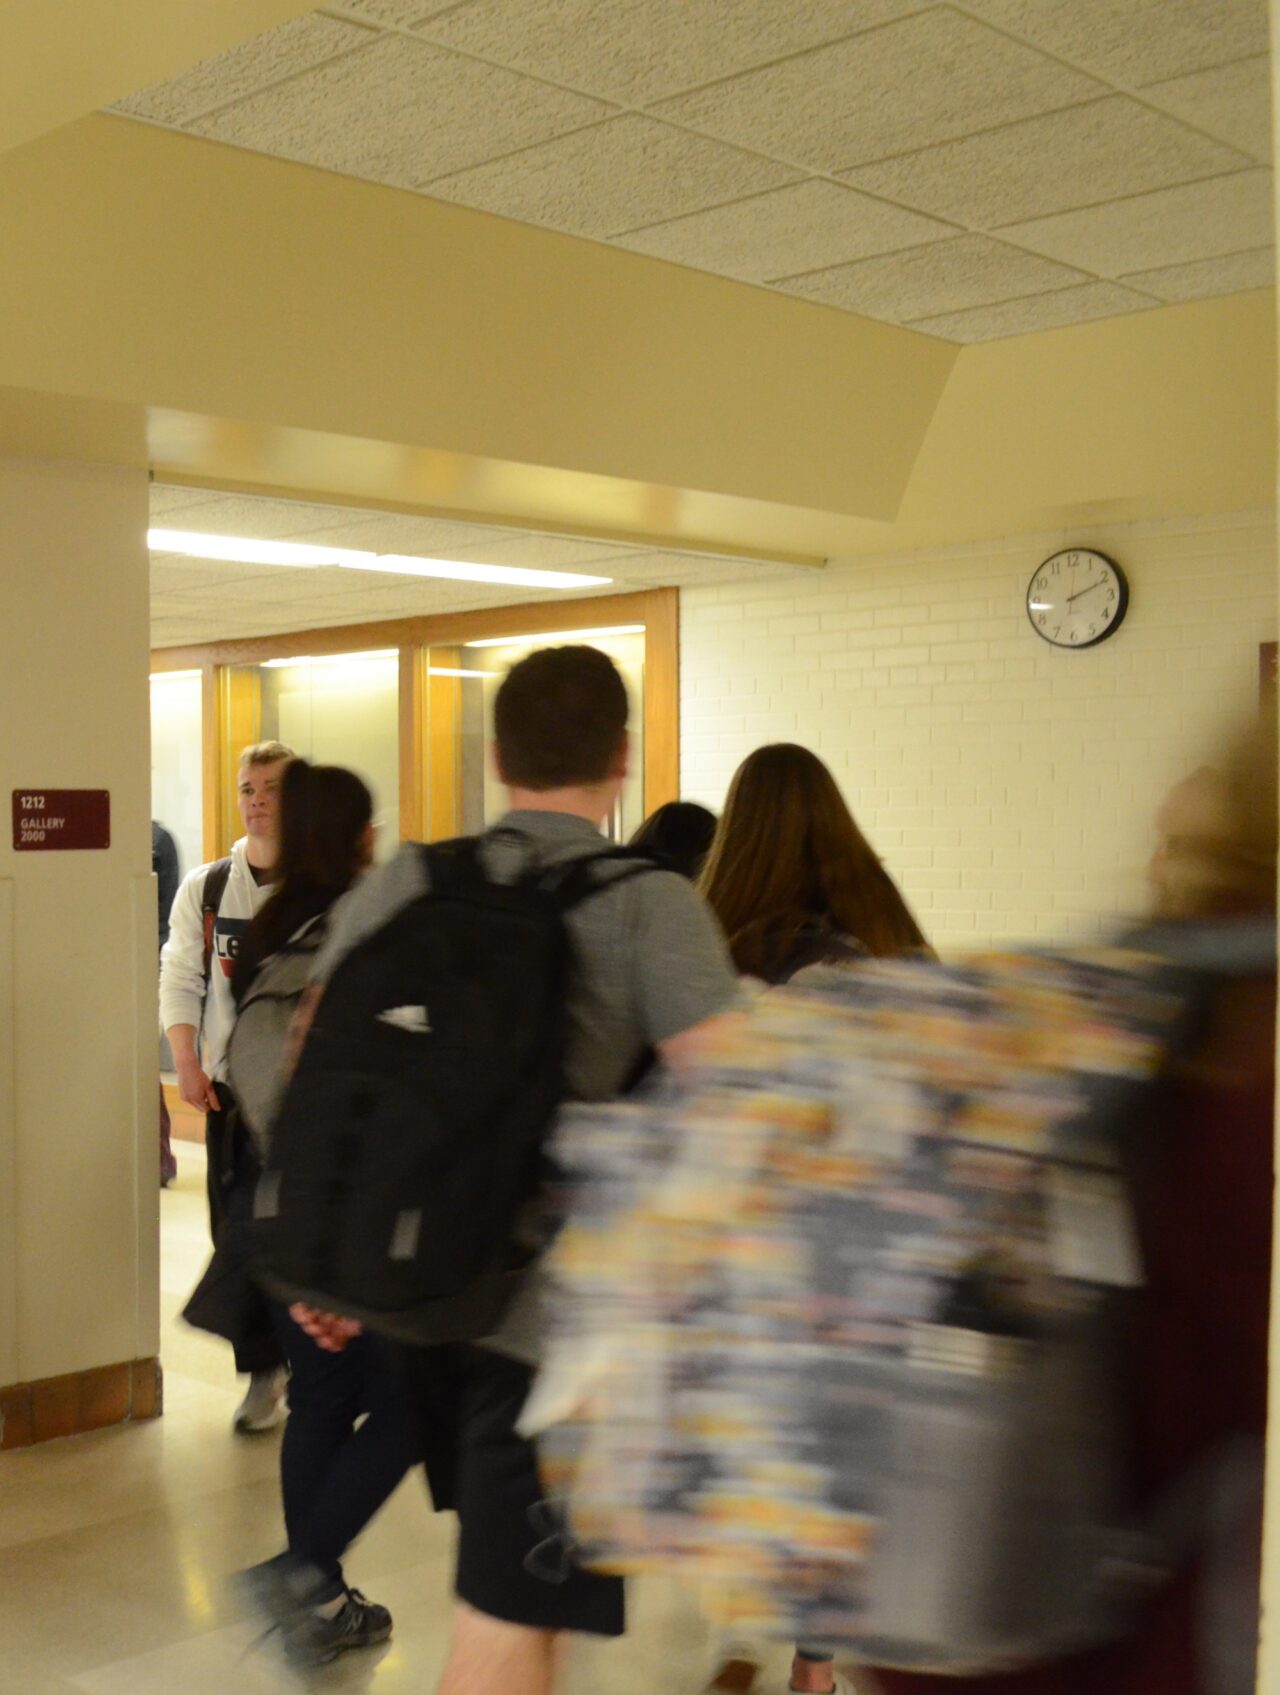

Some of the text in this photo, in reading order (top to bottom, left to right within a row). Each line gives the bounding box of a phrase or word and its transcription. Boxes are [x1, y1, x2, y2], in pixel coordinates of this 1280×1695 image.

[21, 796, 45, 809] 1212
[21, 818, 65, 830] GALLERY
[21, 830, 45, 842] 2000
